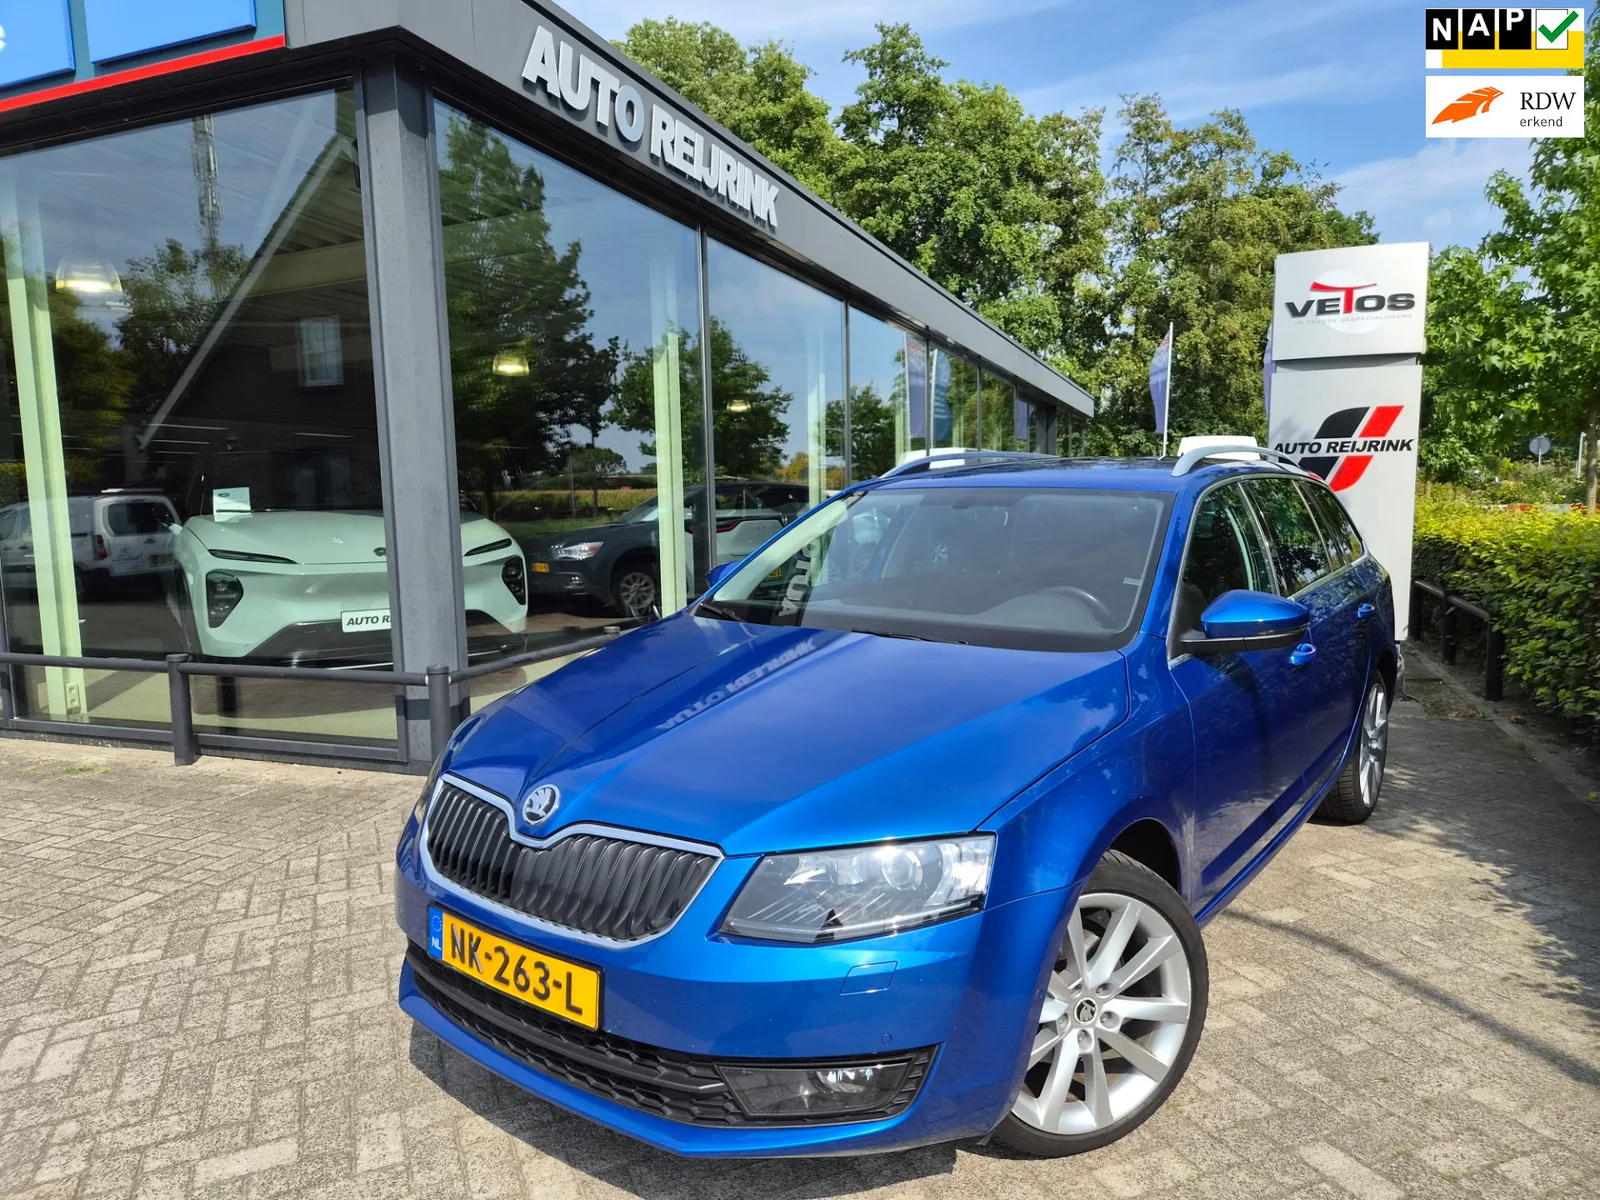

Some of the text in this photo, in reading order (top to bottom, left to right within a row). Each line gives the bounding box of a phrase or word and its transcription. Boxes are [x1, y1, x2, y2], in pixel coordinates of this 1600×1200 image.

[522, 25, 780, 227] AUTO REIJRINK
[1285, 281, 1416, 318] VETOS
[1274, 439, 1414, 454] AUTO REIJRINK
[346, 615, 379, 626] AUTO
[431, 936, 442, 951] NL
[451, 923, 583, 1016] NK-263-L
